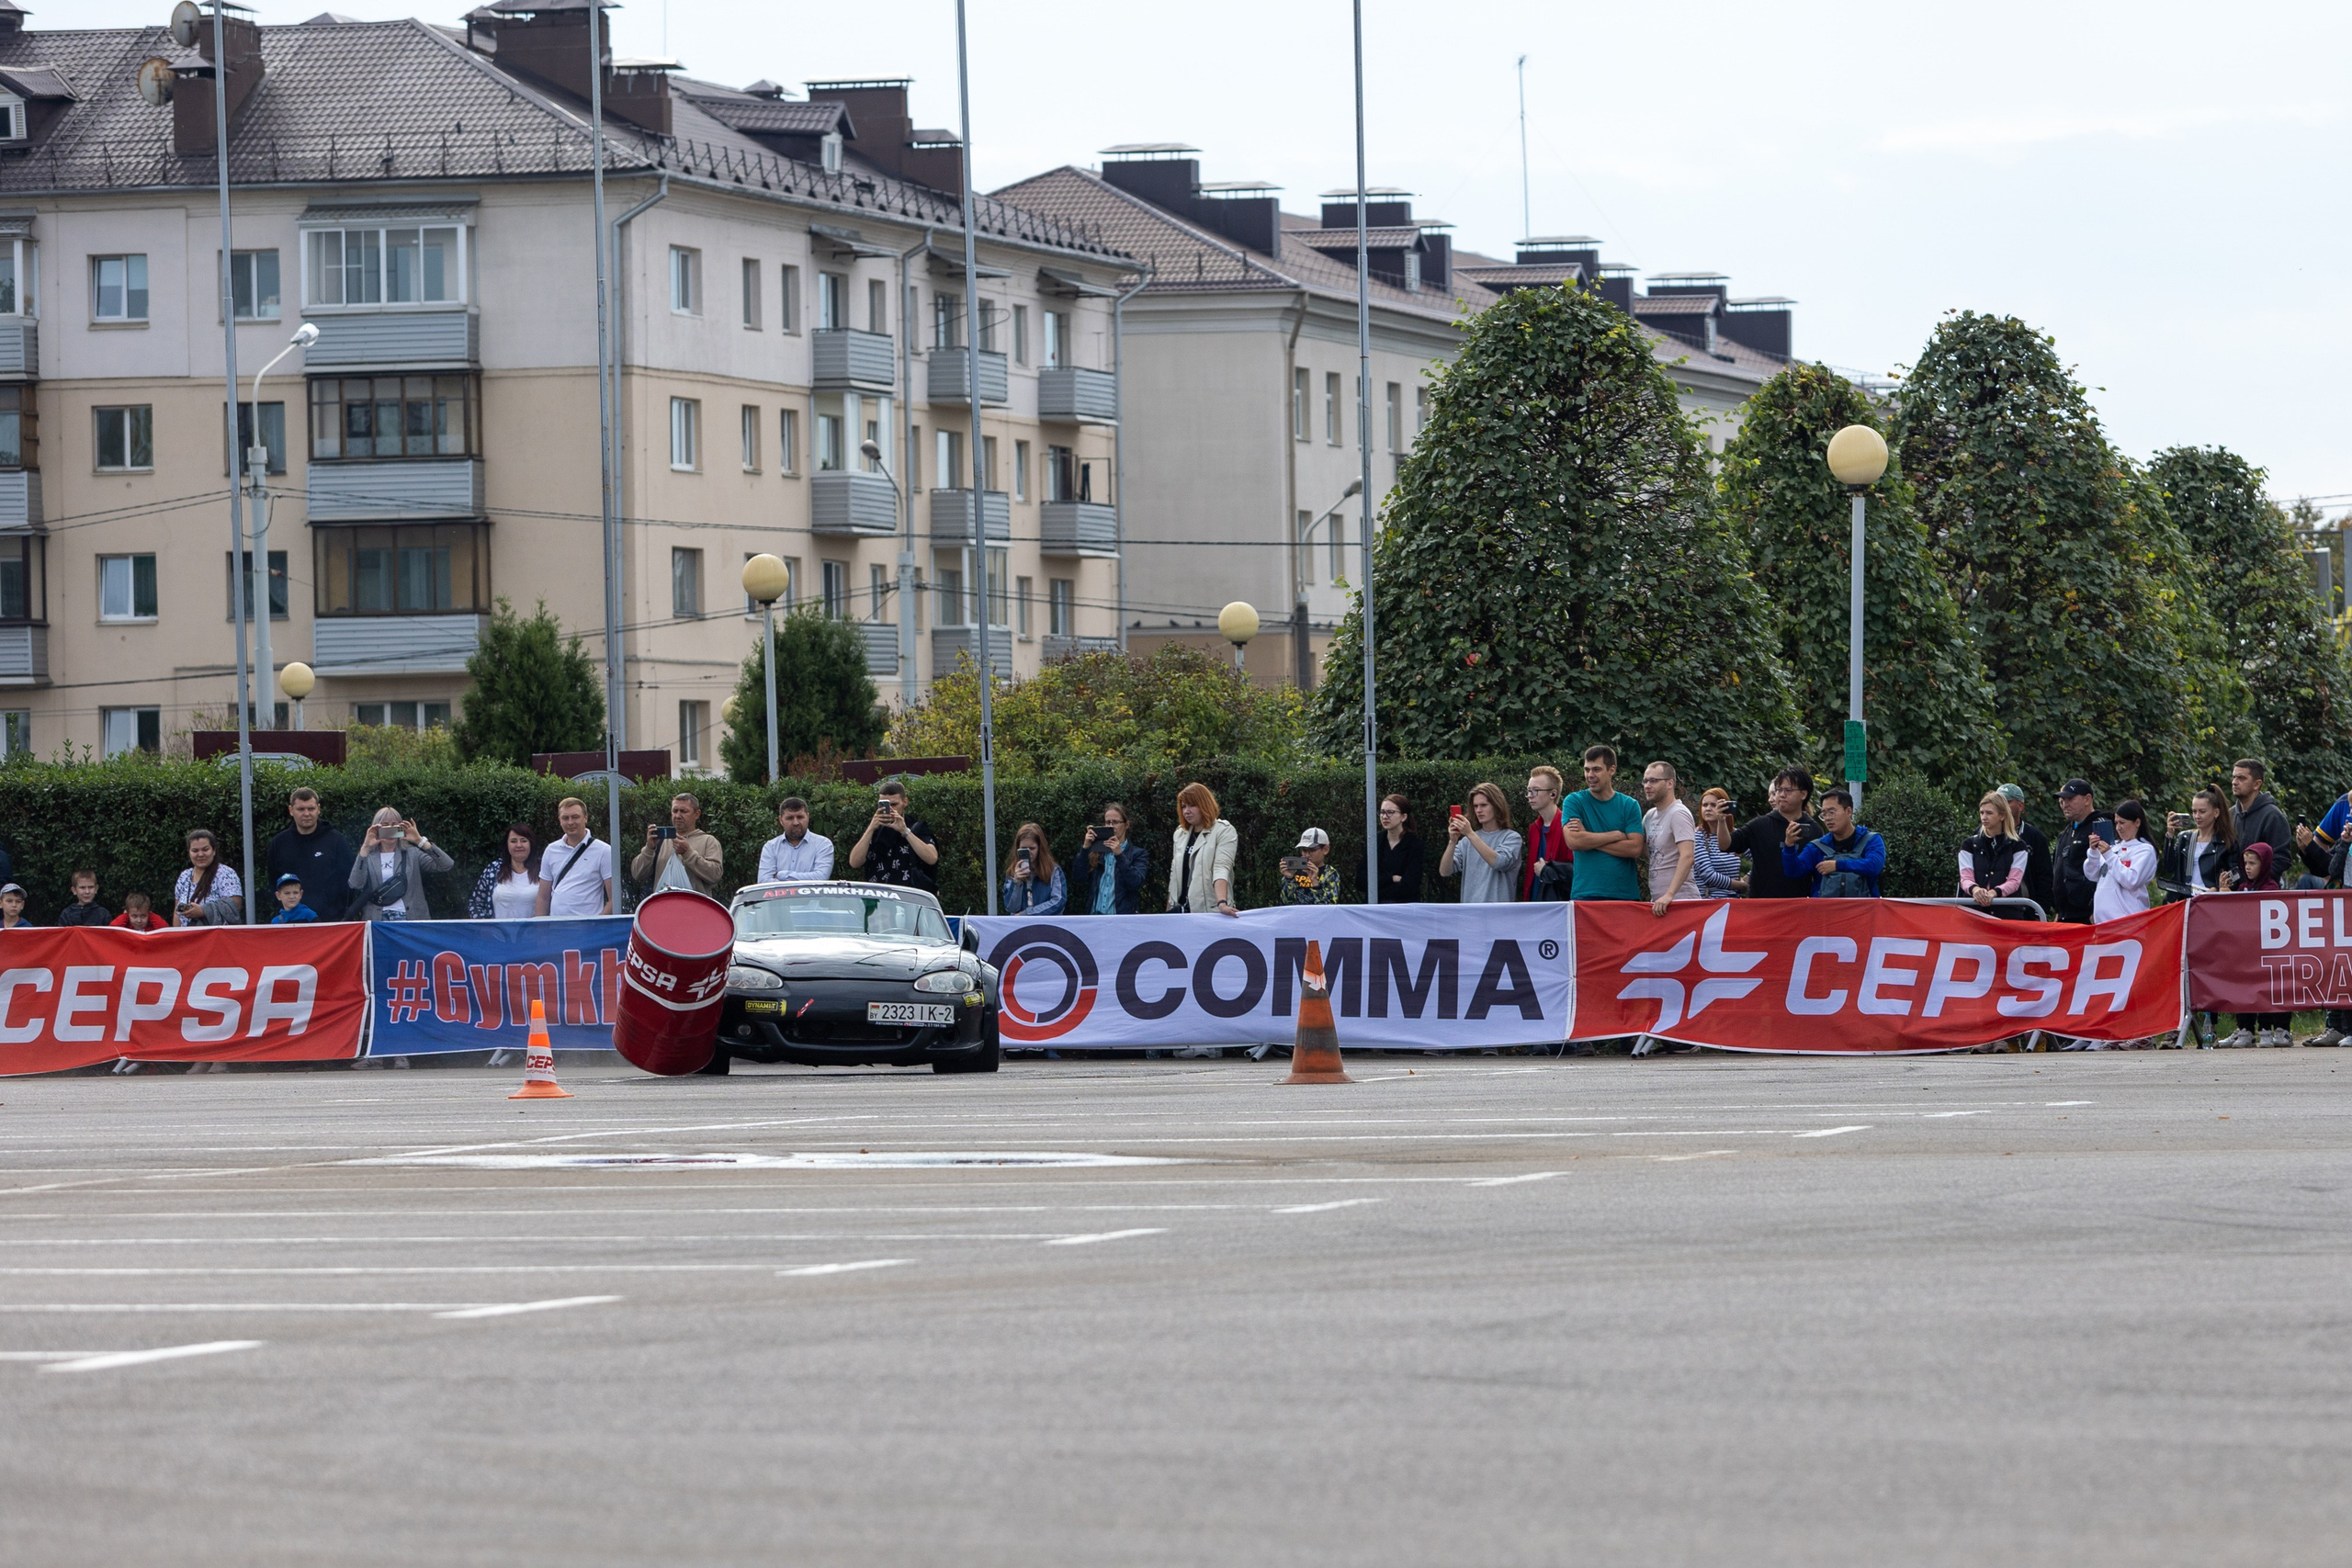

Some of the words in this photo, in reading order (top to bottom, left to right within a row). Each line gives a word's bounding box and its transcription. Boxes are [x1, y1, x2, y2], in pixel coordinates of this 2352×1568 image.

[2260, 897, 2352, 949] BEL
[626, 939, 678, 991] EPSA
[1785, 936, 2143, 1018] CEPSA
[2261, 953, 2352, 1005] TRA
[0, 964, 318, 1043] CEPSA
[882, 1005, 915, 1020] 2323
[526, 1055, 556, 1071] CEP
